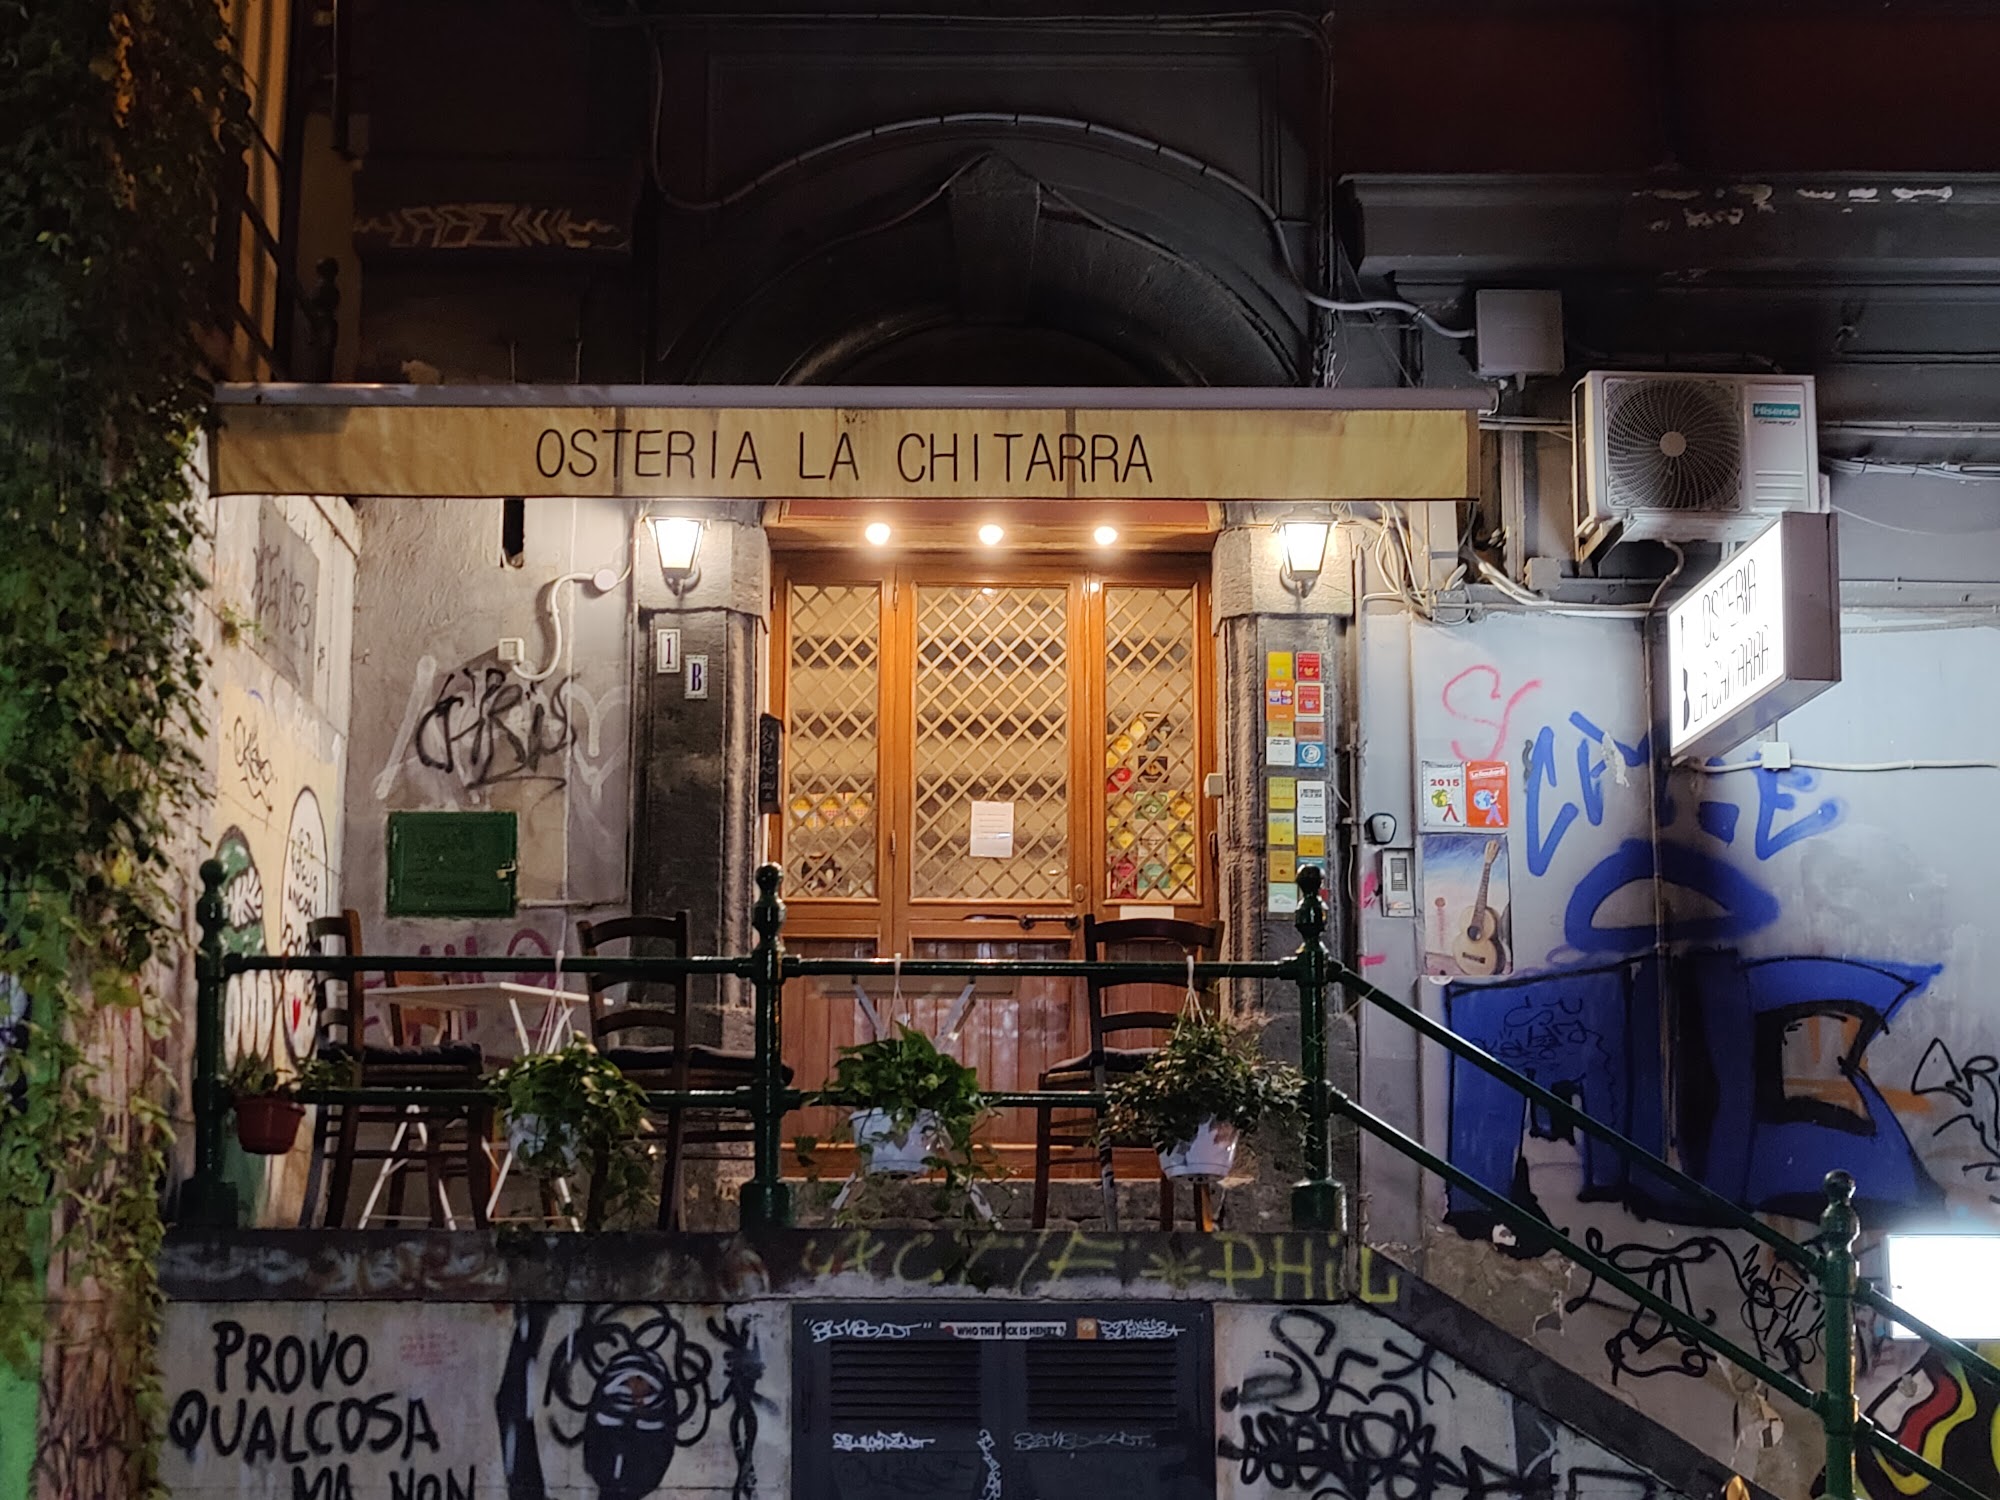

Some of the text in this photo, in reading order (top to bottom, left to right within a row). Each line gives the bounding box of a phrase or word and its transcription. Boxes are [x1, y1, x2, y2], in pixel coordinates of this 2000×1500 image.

[1754, 404, 1799, 417] Hisense
[536, 429, 1153, 484] OSTERIA LA CHITARRA
[1702, 558, 1757, 648] OSTERIA
[691, 662, 702, 691] B
[1430, 778, 1460, 787] 2015
[957, 1326, 978, 1336] WHO
[980, 1326, 995, 1336] THE
[997, 1326, 1018, 1336] FCK
[212, 1320, 369, 1393] PROVO
[169, 1390, 440, 1463] QUALCOSA
[389, 1464, 476, 1500] NON
